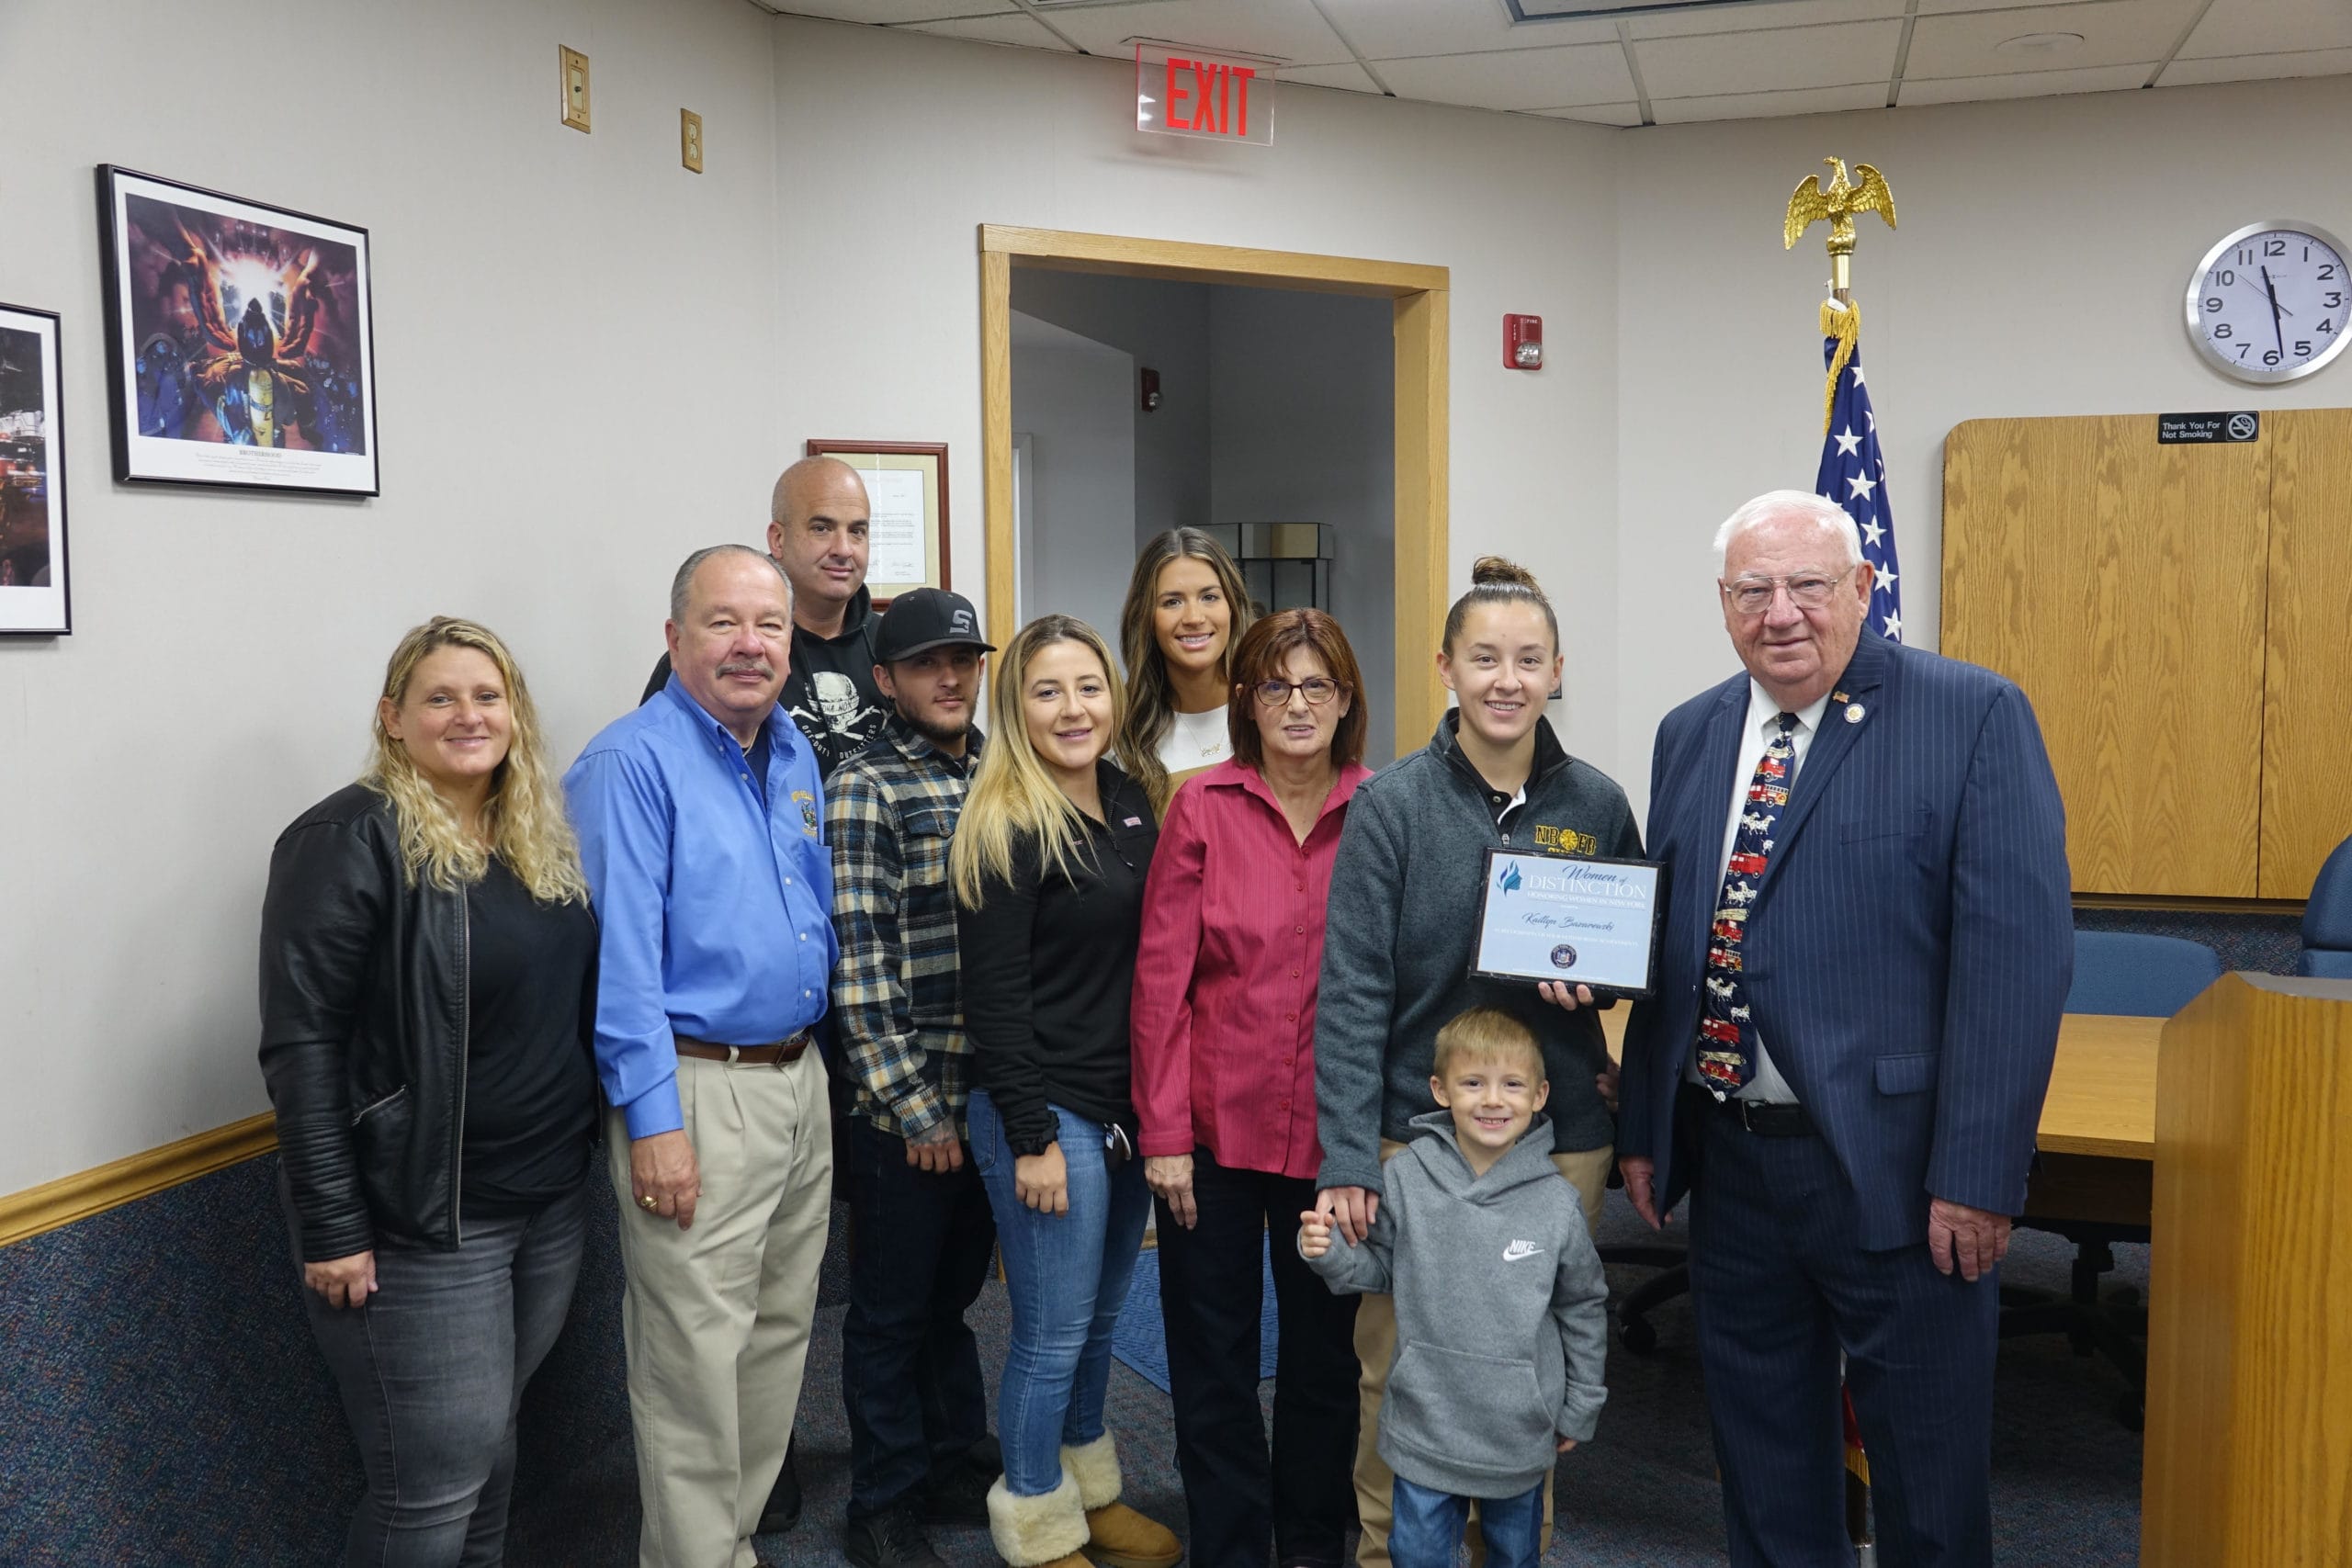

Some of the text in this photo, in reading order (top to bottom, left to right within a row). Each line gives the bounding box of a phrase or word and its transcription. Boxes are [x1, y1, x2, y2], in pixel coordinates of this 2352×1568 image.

[1166, 57, 1255, 137] EXIT
[2264, 240, 2286, 257] 12
[2303, 246, 2309, 263] 1
[2238, 249, 2254, 266] 11
[2216, 269, 2235, 288] 10
[2317, 264, 2335, 281] 2
[2206, 297, 2223, 313] 9
[2323, 291, 2342, 310] 3
[2214, 323, 2233, 340] 8
[2316, 318, 2333, 334] 4
[2235, 343, 2252, 359] 7
[2293, 340, 2312, 356] 5
[2262, 350, 2280, 367] 6
[2162, 421, 2221, 431] Thank You For
[2162, 430, 2212, 439] Not Smoking
[1562, 863, 1628, 886] Women of
[1529, 874, 1647, 899] DISTINCTION
[1569, 895, 1599, 905] WOMEN
[1510, 1239, 1536, 1253] NIKE
